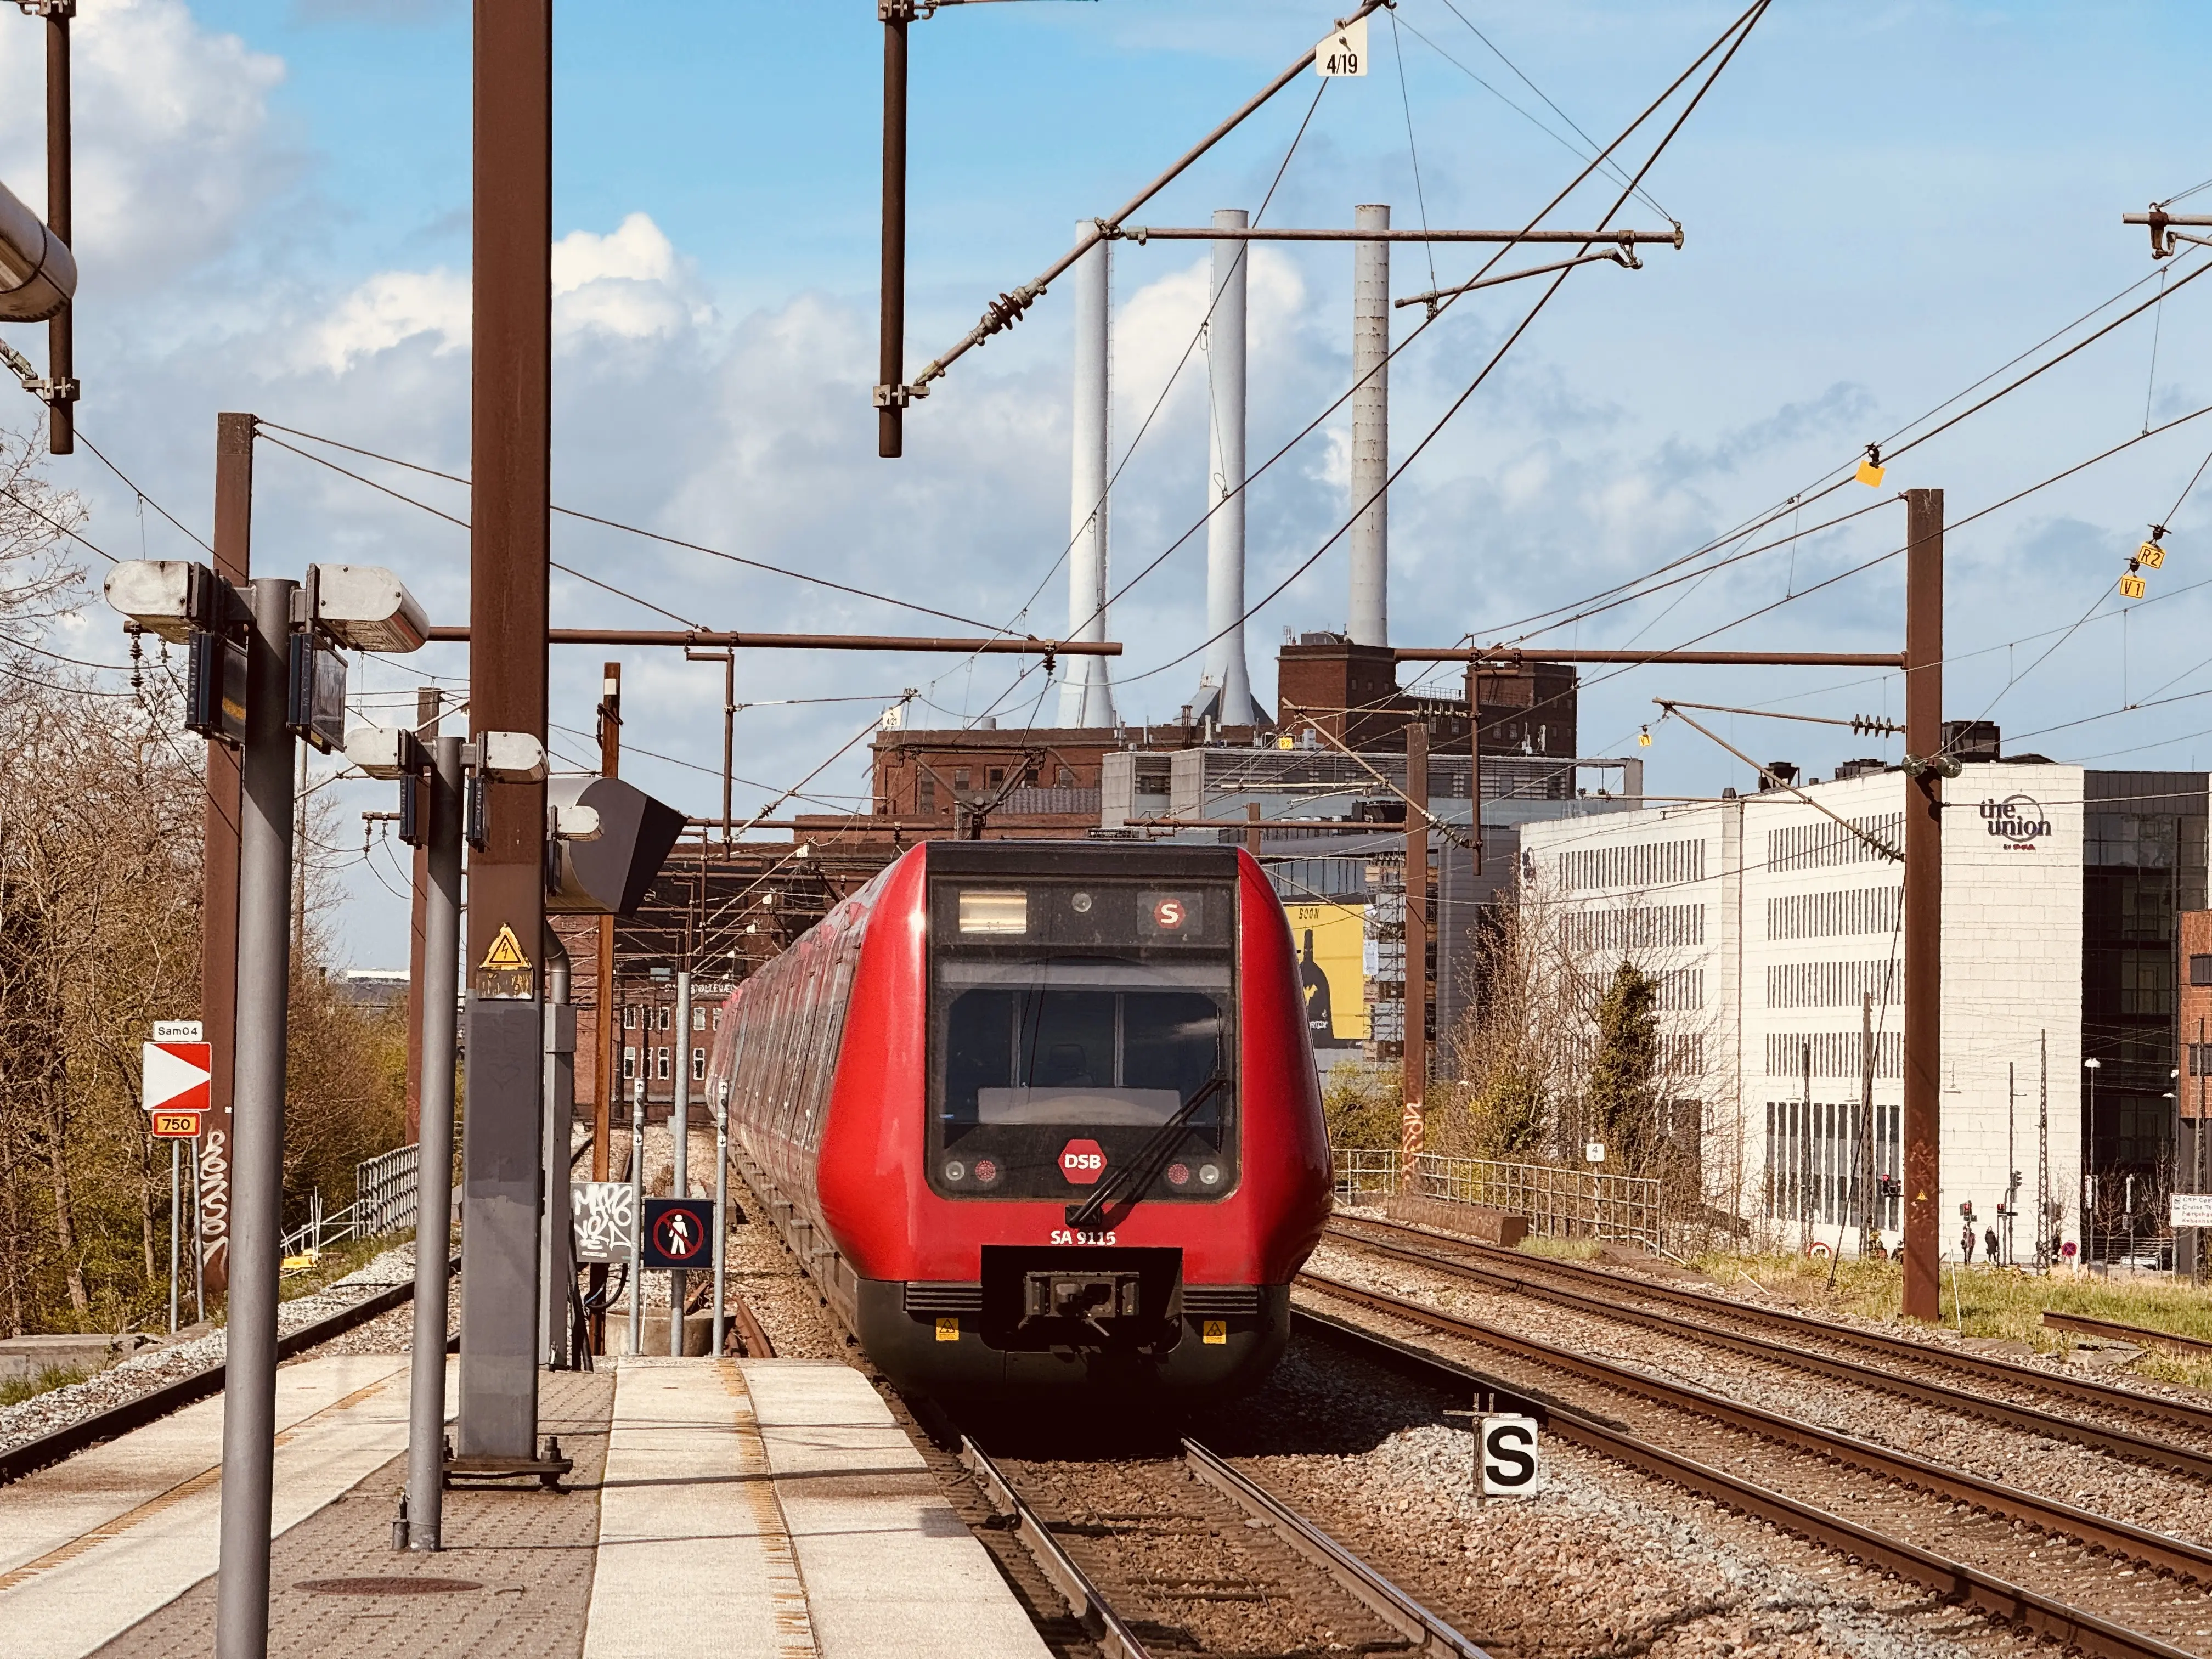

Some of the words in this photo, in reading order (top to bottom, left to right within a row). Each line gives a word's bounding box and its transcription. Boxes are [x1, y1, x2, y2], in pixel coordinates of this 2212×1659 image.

[1327, 53, 1358, 75] 4/19
[2140, 548, 2161, 567] R2
[2124, 580, 2141, 596] V1
[1281, 740, 1290, 748] R2
[1979, 798, 2016, 819] the
[1987, 815, 2052, 836] union
[1160, 904, 1178, 924] S
[1299, 908, 1320, 920] SOON
[157, 1026, 198, 1036] Sam04
[162, 1118, 191, 1131] 750
[1064, 1154, 1102, 1169] DSB
[1051, 1230, 1073, 1245] SA
[1077, 1231, 1116, 1245] 9115
[1485, 1425, 1535, 1487] S
